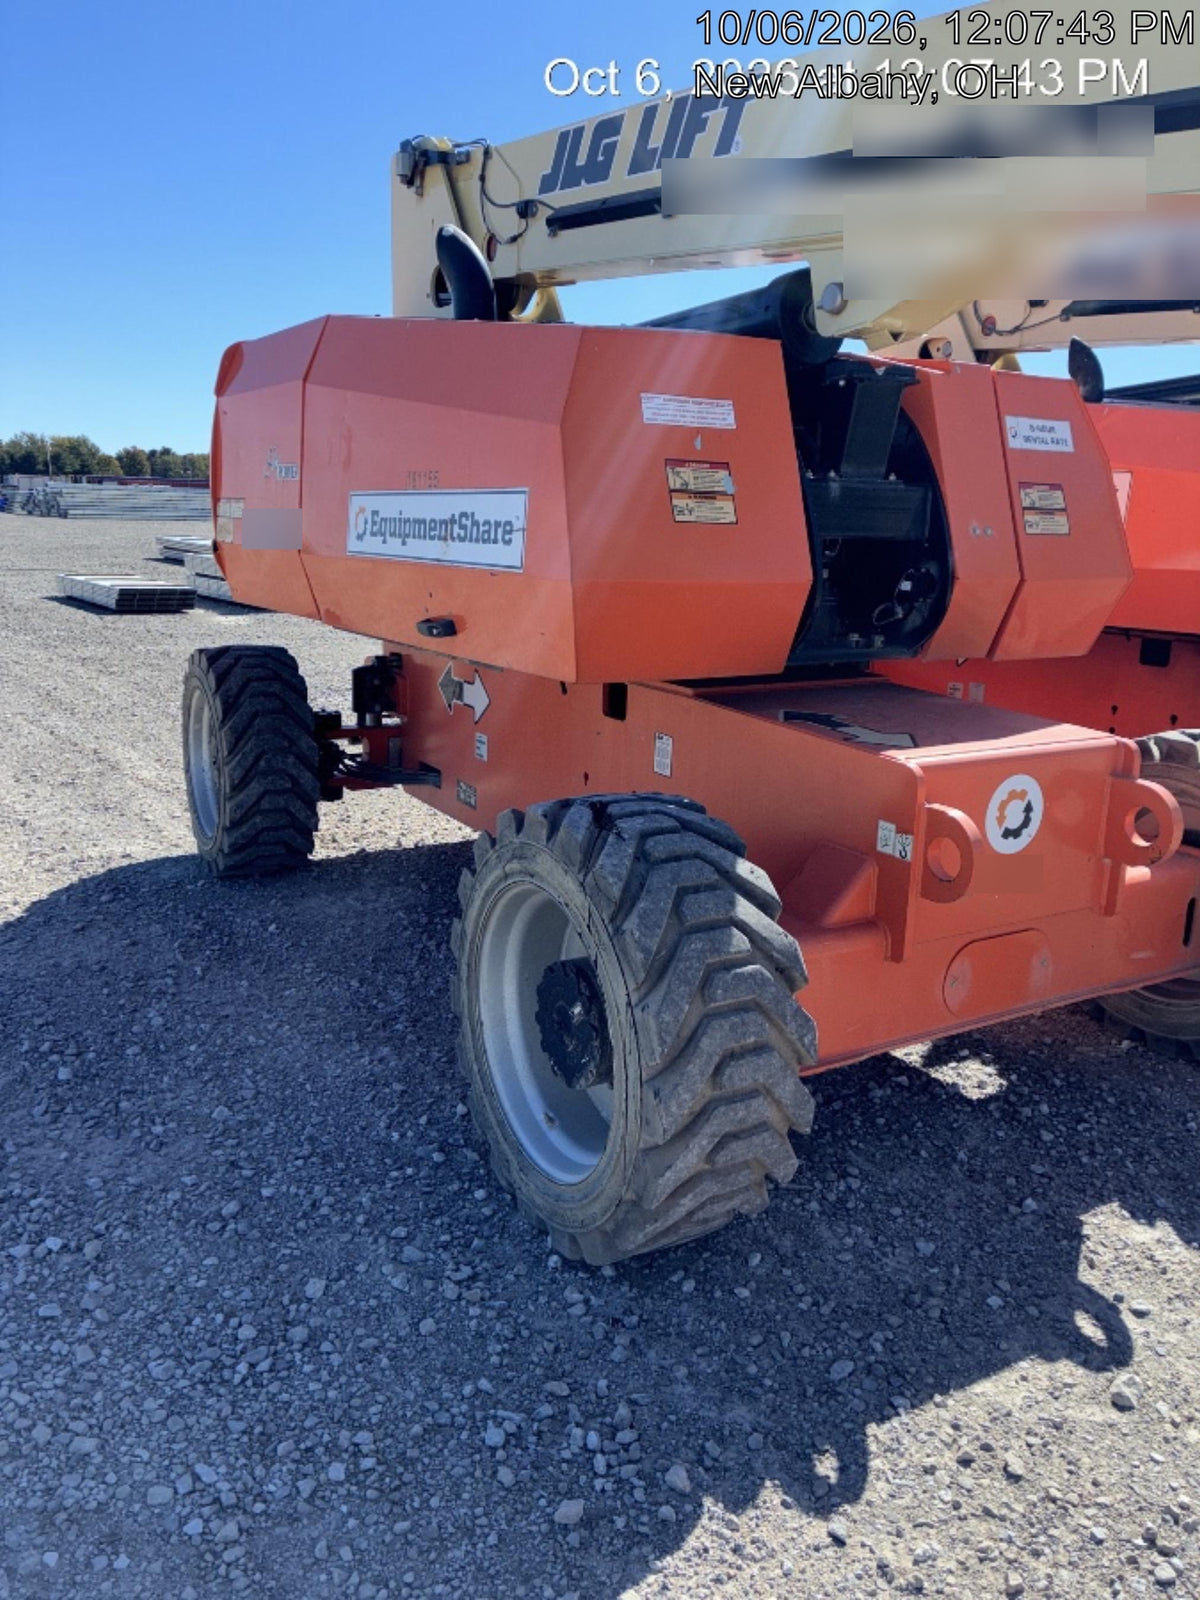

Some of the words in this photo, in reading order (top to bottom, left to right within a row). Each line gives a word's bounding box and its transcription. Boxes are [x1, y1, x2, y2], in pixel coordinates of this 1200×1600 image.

[537, 109, 628, 197] JLG
[626, 82, 759, 176] LIFT
[369, 509, 514, 546] EquipmentShare
